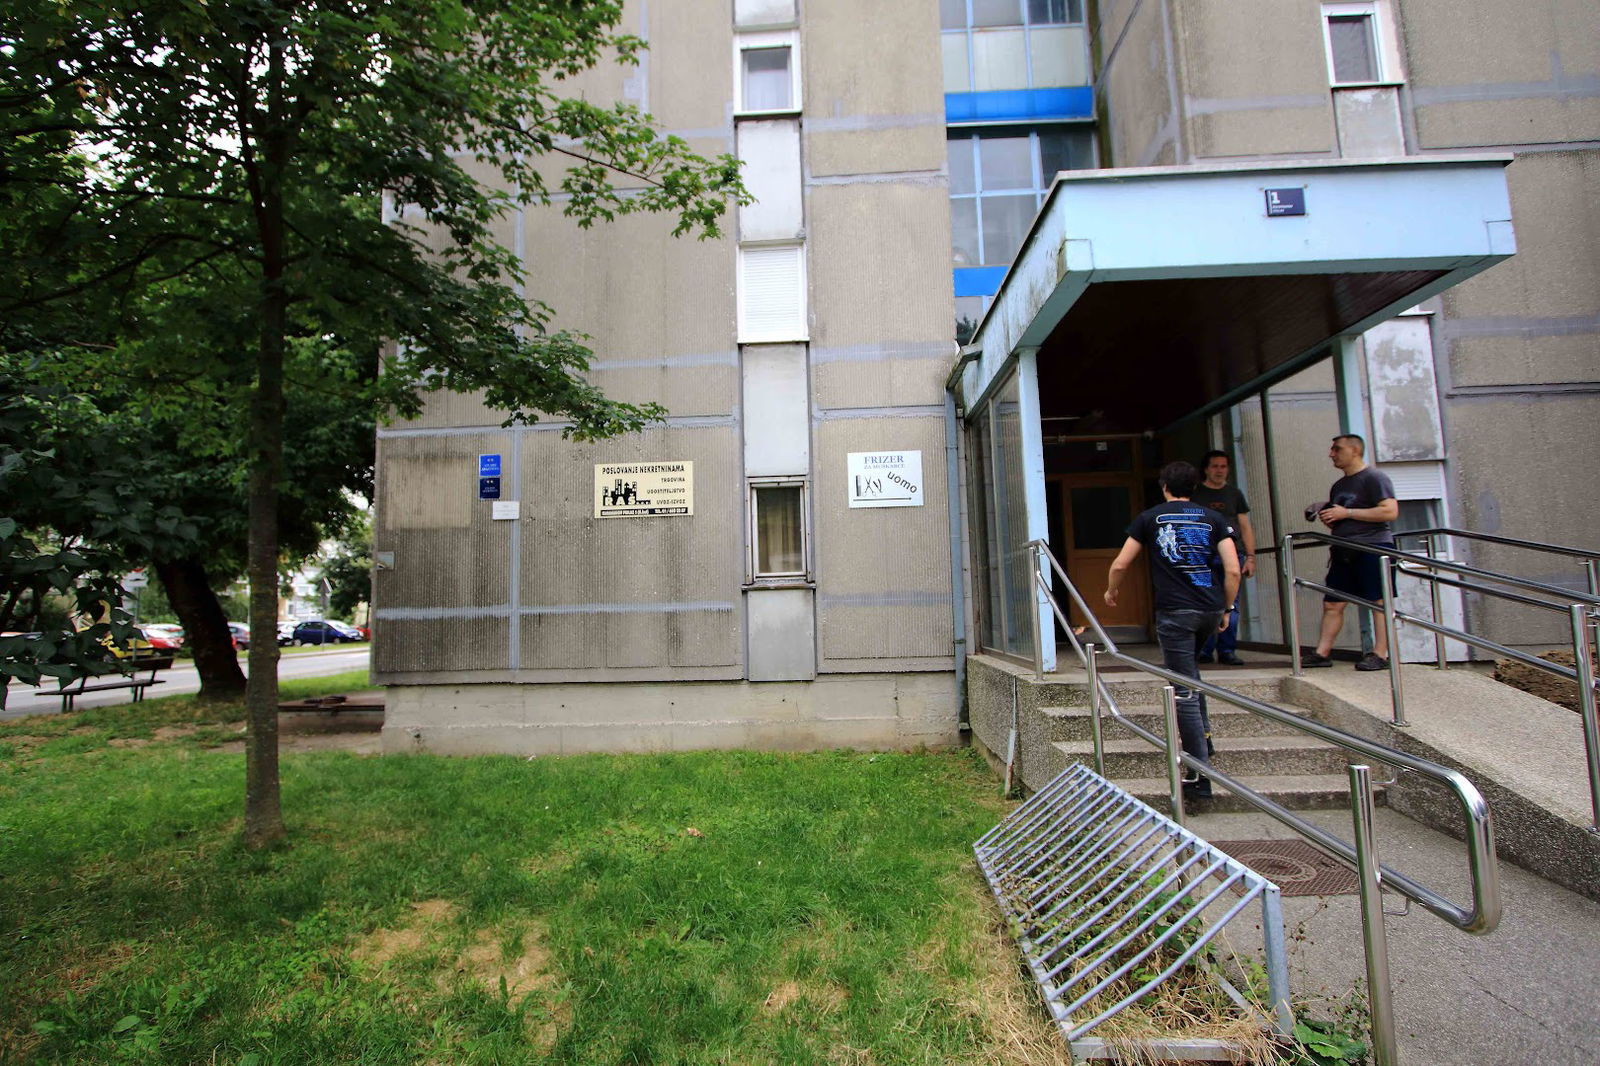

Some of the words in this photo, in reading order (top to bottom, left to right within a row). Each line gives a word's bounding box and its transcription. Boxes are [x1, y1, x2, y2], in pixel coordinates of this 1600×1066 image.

[864, 455, 904, 464] FRIZER
[602, 466, 638, 475] POSLOVANJE
[640, 464, 685, 474] NEKRETNINAMA
[887, 471, 918, 494] uomo
